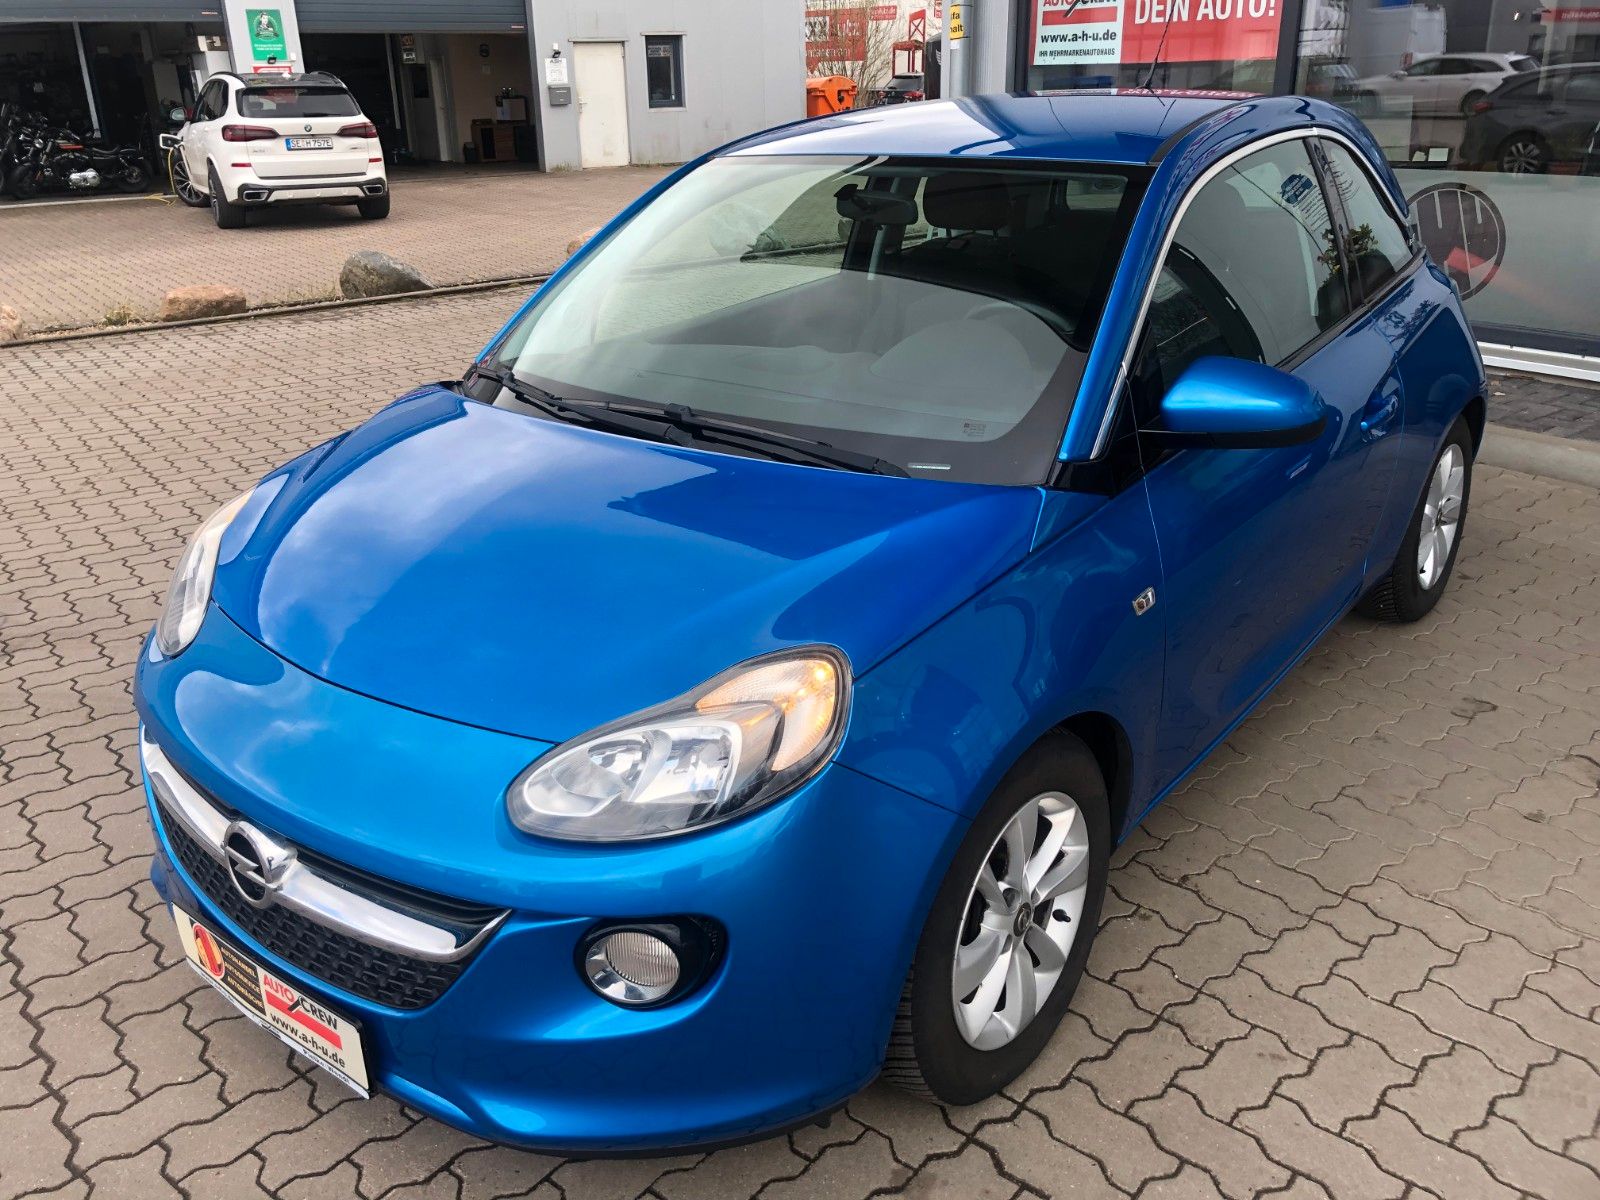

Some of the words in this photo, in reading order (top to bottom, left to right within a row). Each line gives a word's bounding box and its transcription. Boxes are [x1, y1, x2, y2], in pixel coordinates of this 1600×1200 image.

[1135, 0, 1190, 25] DEIN
[1197, 0, 1276, 21] AUTO!
[1041, 29, 1117, 44] www.a-h-u.de
[1049, 48, 1115, 57] MEHRMARKENAUTOHAUS
[291, 139, 302, 148] SE
[264, 974, 295, 1002] AUTO
[300, 997, 338, 1030] CREW
[271, 1013, 346, 1068] www.a-h-u.de
